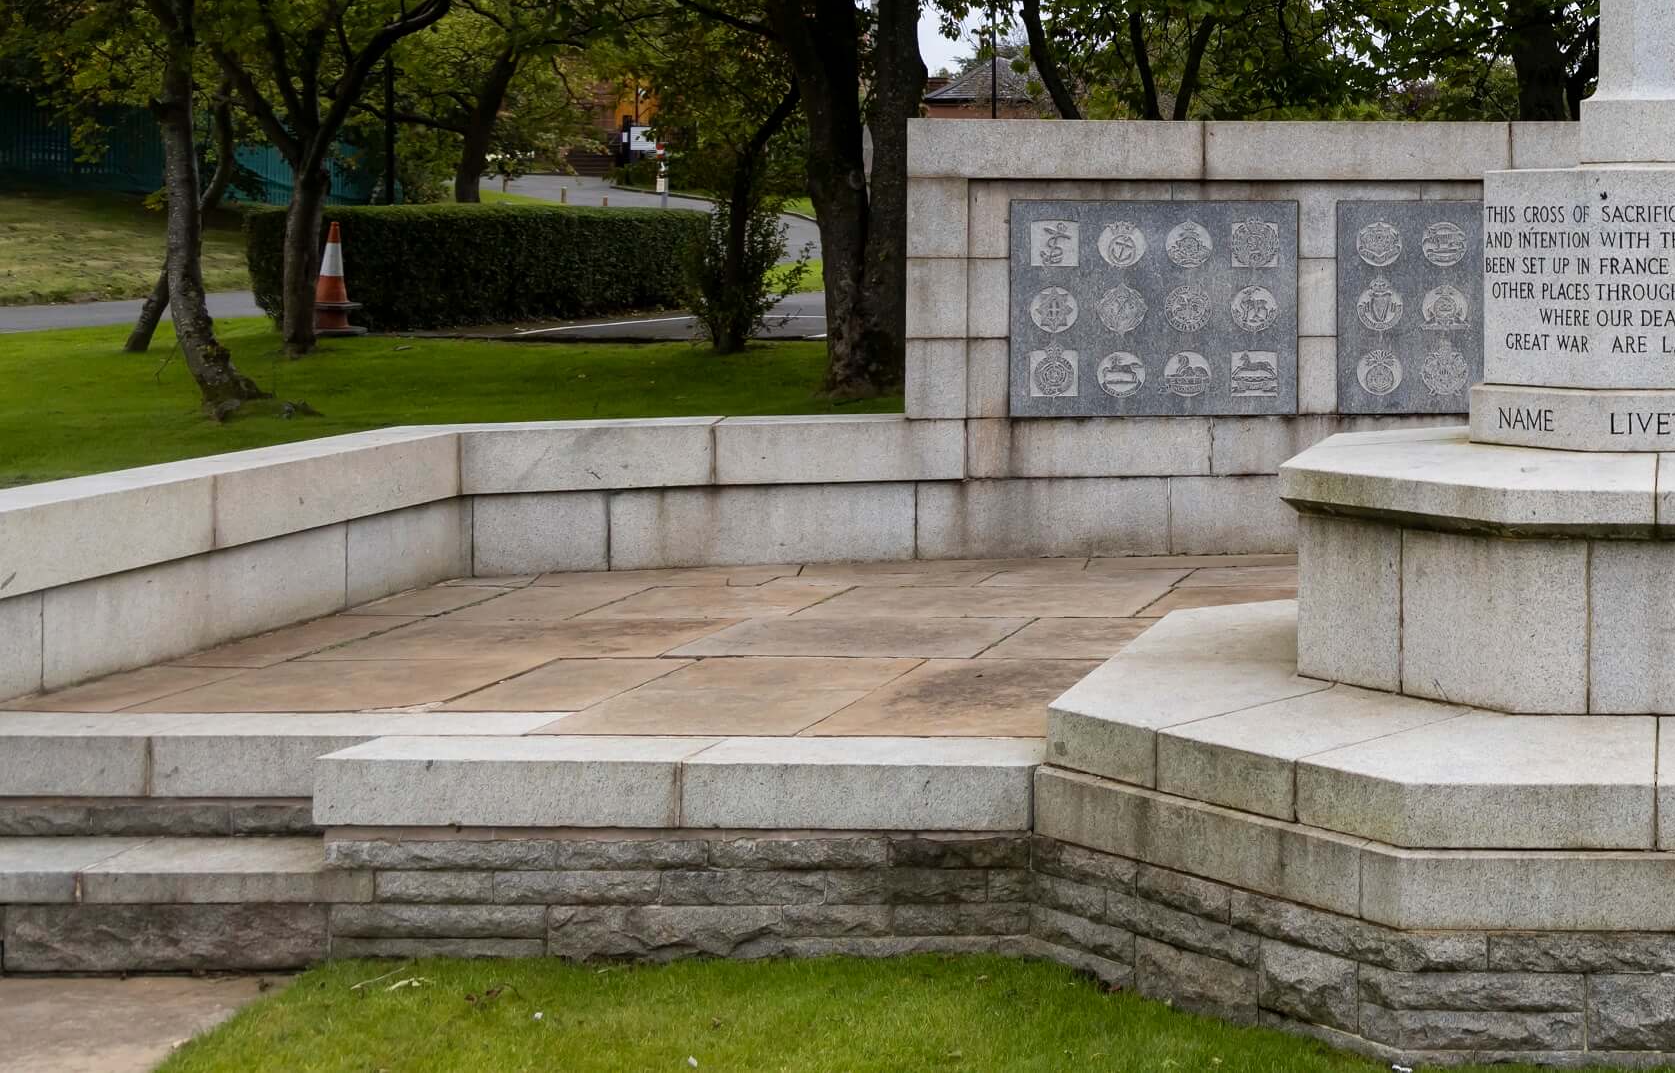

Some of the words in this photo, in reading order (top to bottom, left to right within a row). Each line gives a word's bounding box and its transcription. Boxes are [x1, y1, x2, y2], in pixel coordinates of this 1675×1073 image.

[1486, 206, 1515, 224] THIS
[1524, 206, 1564, 223] CROSS
[1573, 206, 1589, 223] OF
[1487, 232, 1512, 248] AND
[1519, 232, 1590, 248] INTENTION
[1600, 232, 1649, 249] WITH
[1486, 257, 1514, 273] BEEN
[1522, 257, 1546, 274] SET
[1553, 258, 1569, 274] UP
[1577, 258, 1589, 275] IN
[1600, 257, 1668, 274] FRANCE
[1492, 282, 1534, 299] OTHER
[1542, 283, 1589, 300] PLACES
[1539, 309, 1589, 326] WHERE
[1597, 310, 1633, 326] OUR
[1506, 333, 1550, 350] GREAT
[1557, 335, 1589, 353] WAR
[1612, 336, 1647, 353] ARE
[1499, 407, 1554, 431] NAME
